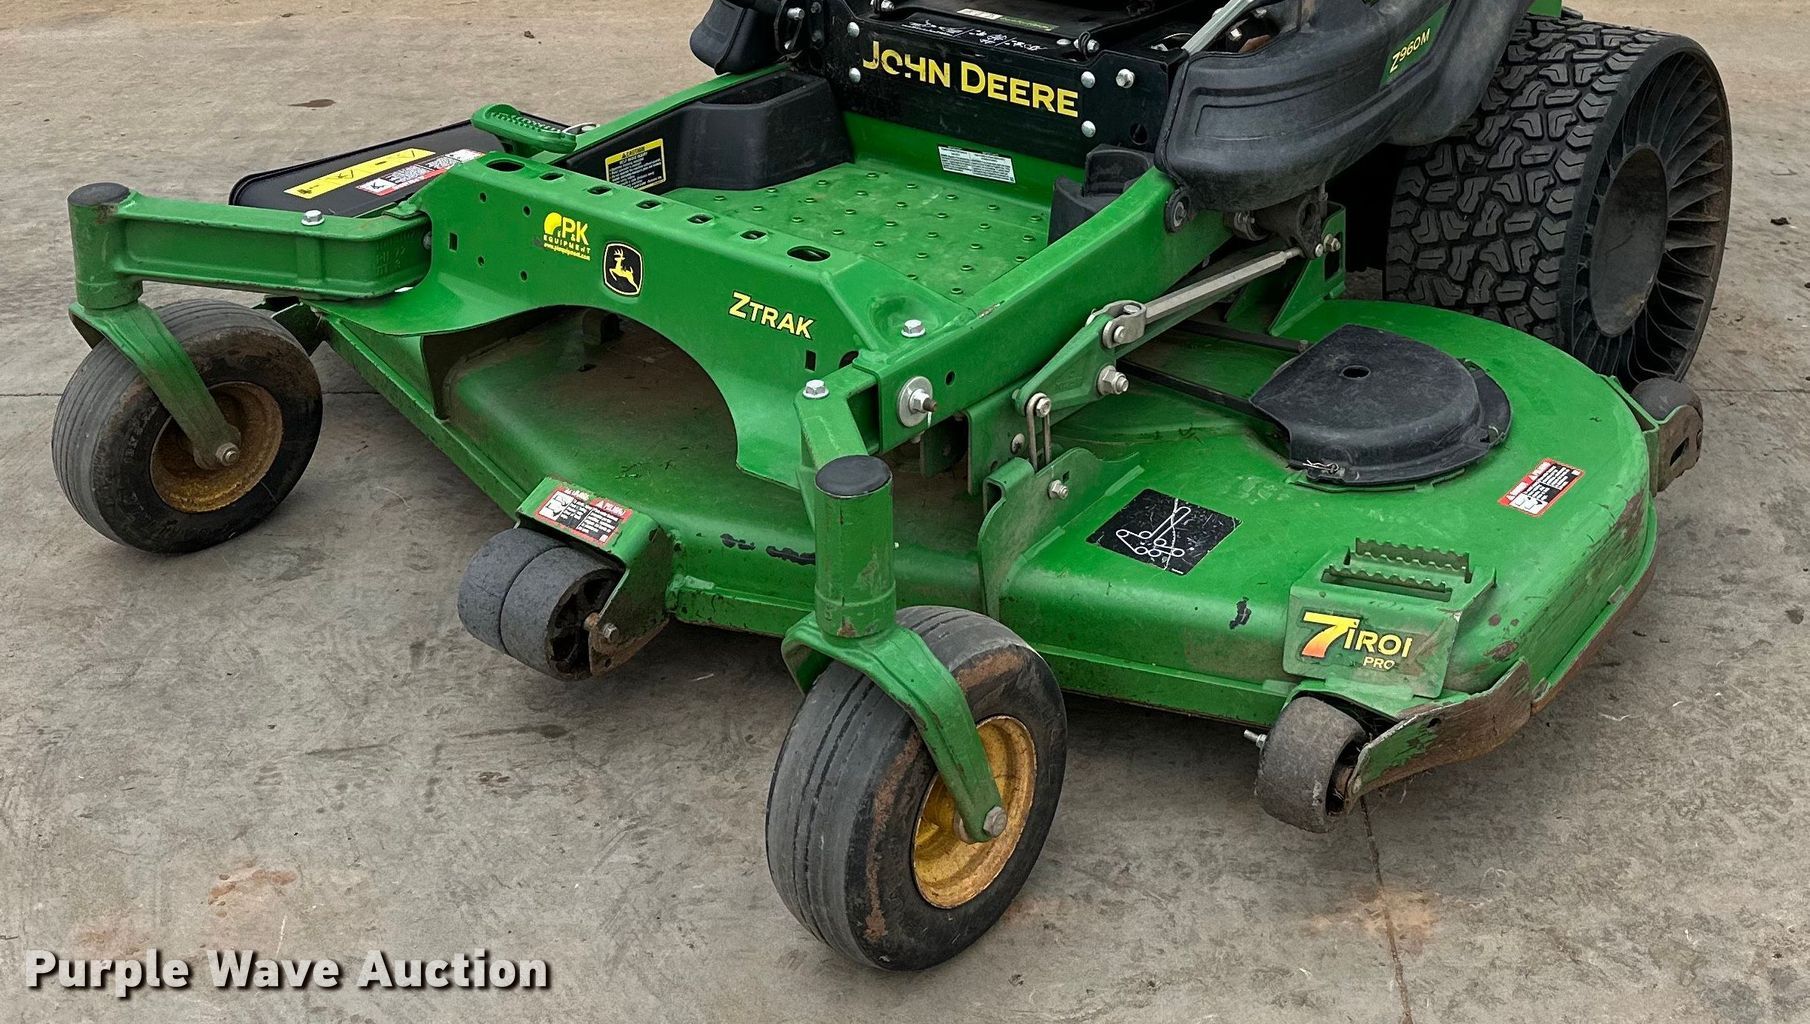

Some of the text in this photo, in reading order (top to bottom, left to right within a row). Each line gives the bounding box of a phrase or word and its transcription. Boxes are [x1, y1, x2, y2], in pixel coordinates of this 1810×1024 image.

[1389, 27, 1431, 74] Z960M
[862, 40, 1079, 118] JOHN DEERE
[543, 234, 591, 254] EQUIPMENT
[728, 290, 815, 340] ZTRAK
[1362, 655, 1396, 670] PRO
